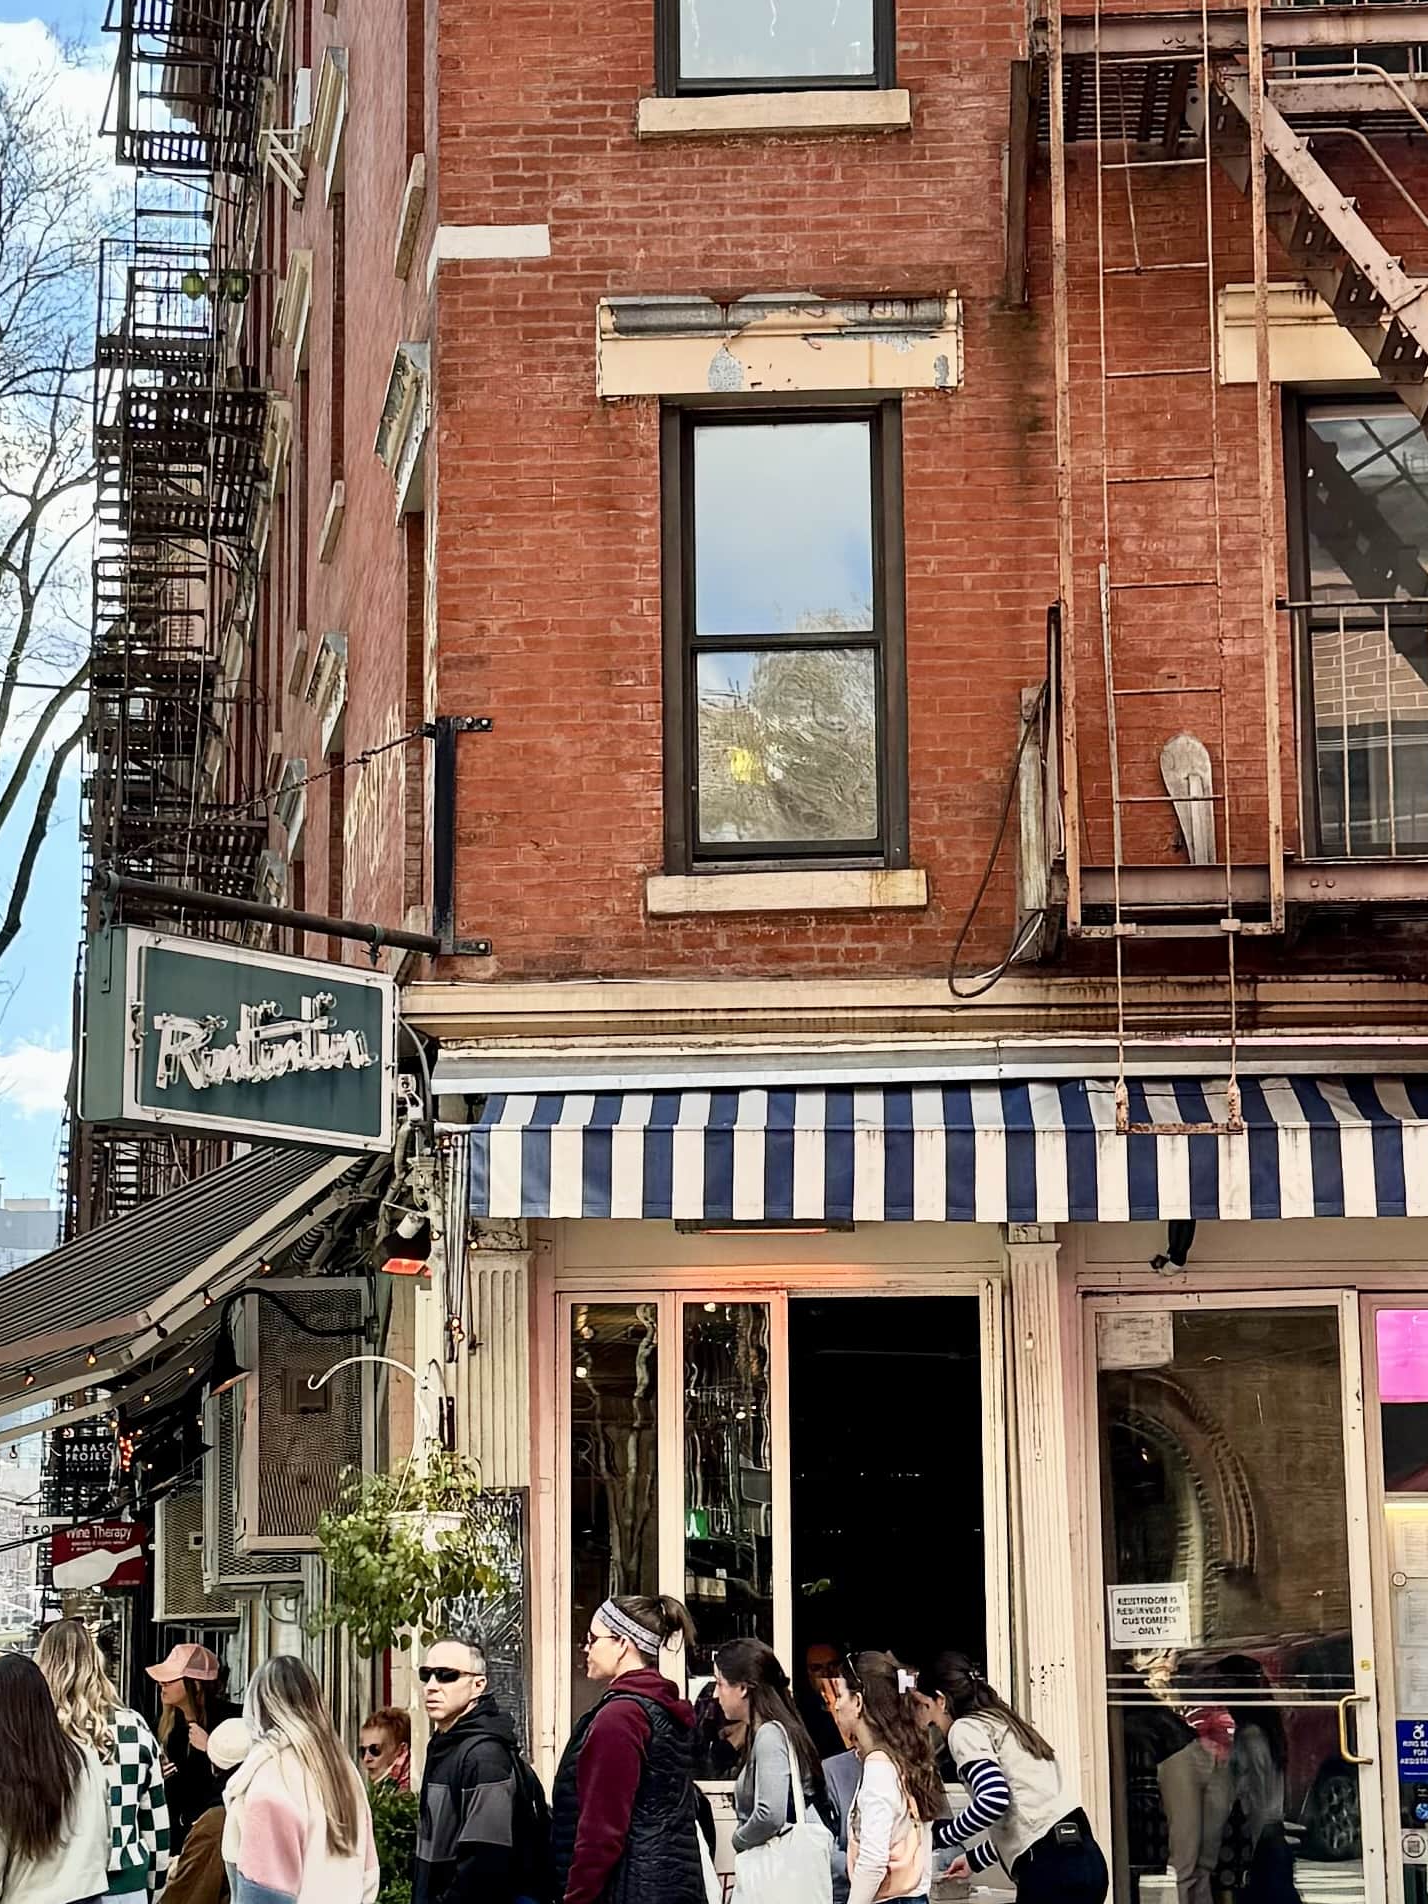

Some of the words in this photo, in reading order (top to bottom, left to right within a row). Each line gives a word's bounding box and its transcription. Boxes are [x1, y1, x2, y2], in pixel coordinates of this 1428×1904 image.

[65, 1452, 110, 1462] PROJEC
[92, 1525, 132, 1541] Therapy
[1121, 1616, 1177, 1625] CUSTOMERS
